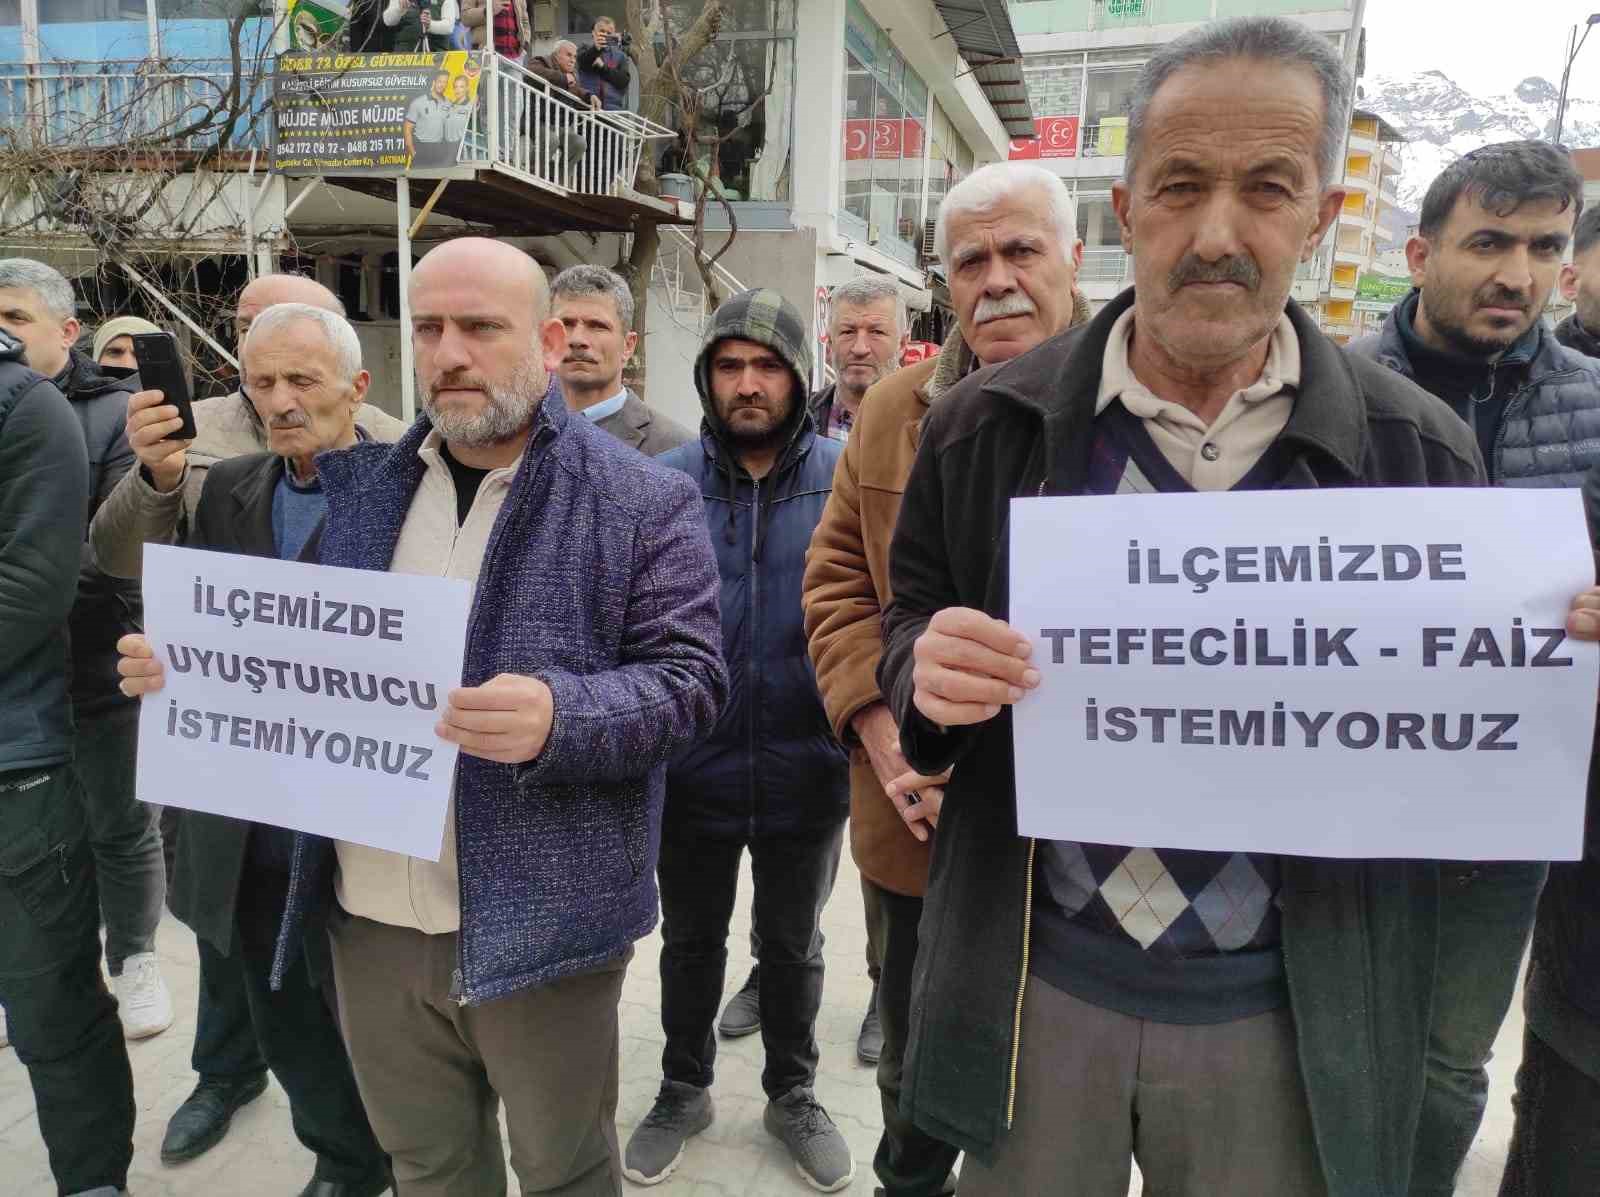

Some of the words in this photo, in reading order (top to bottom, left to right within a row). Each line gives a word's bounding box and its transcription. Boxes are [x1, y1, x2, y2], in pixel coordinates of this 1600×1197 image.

[317, 56, 331, 69] 72
[335, 54, 366, 69] ÖZEL
[370, 52, 434, 67] GÜVENLİK
[341, 77, 383, 88] KUSURSUZ
[385, 74, 428, 87] GÜVENLİK
[278, 109, 318, 128] MÜJDE
[321, 107, 360, 127] MÜJDE
[362, 104, 405, 123] MÜJDE
[347, 140, 367, 153] 0488
[369, 139, 384, 152] 215
[386, 139, 395, 150] 71
[397, 138, 405, 150] 71
[380, 154, 406, 165] BATMAN
[1128, 536, 1466, 594] İLÇEMİZDE
[193, 576, 404, 642] İLÇEMİZDE
[1040, 618, 1359, 667] TEFECİLİK
[1380, 648, 1398, 657] -
[1422, 617, 1573, 667] FAİZ
[166, 644, 438, 711] UYUŞTURUCU
[167, 699, 433, 781] İSTEMİYORUZ
[1085, 697, 1519, 750] İSTEMİYORUZ
